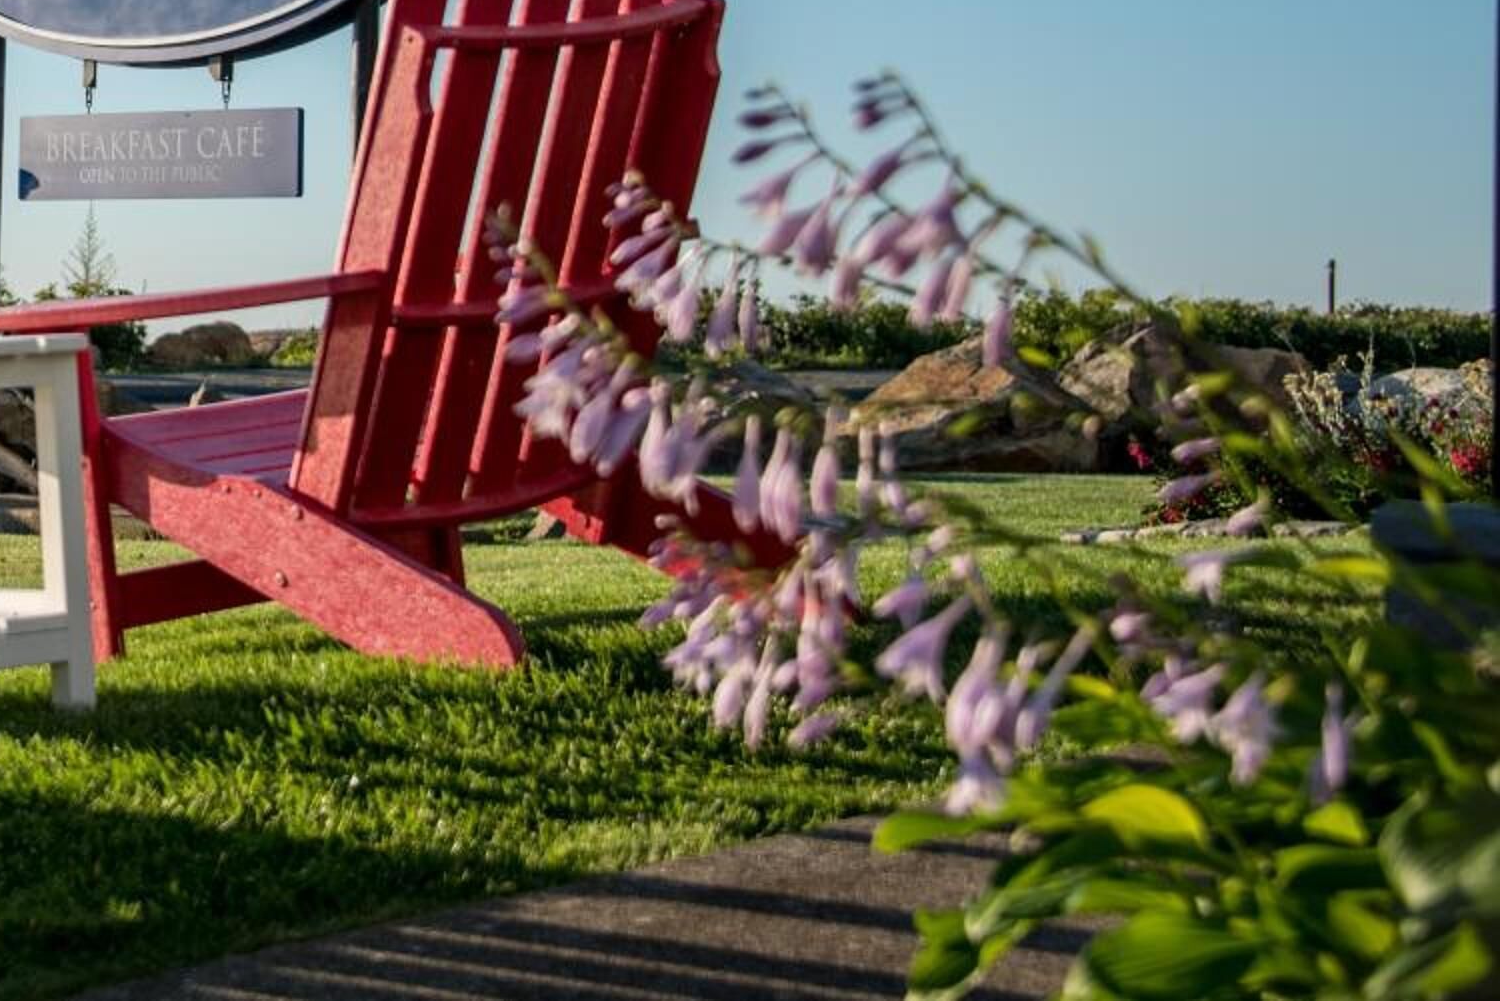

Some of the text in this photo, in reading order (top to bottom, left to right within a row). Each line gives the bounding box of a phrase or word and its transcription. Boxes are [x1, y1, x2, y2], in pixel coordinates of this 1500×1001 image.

[47, 121, 265, 162] BREAKFAST CAFÉ
[79, 167, 116, 184] OPEN
[117, 166, 138, 183] TO
